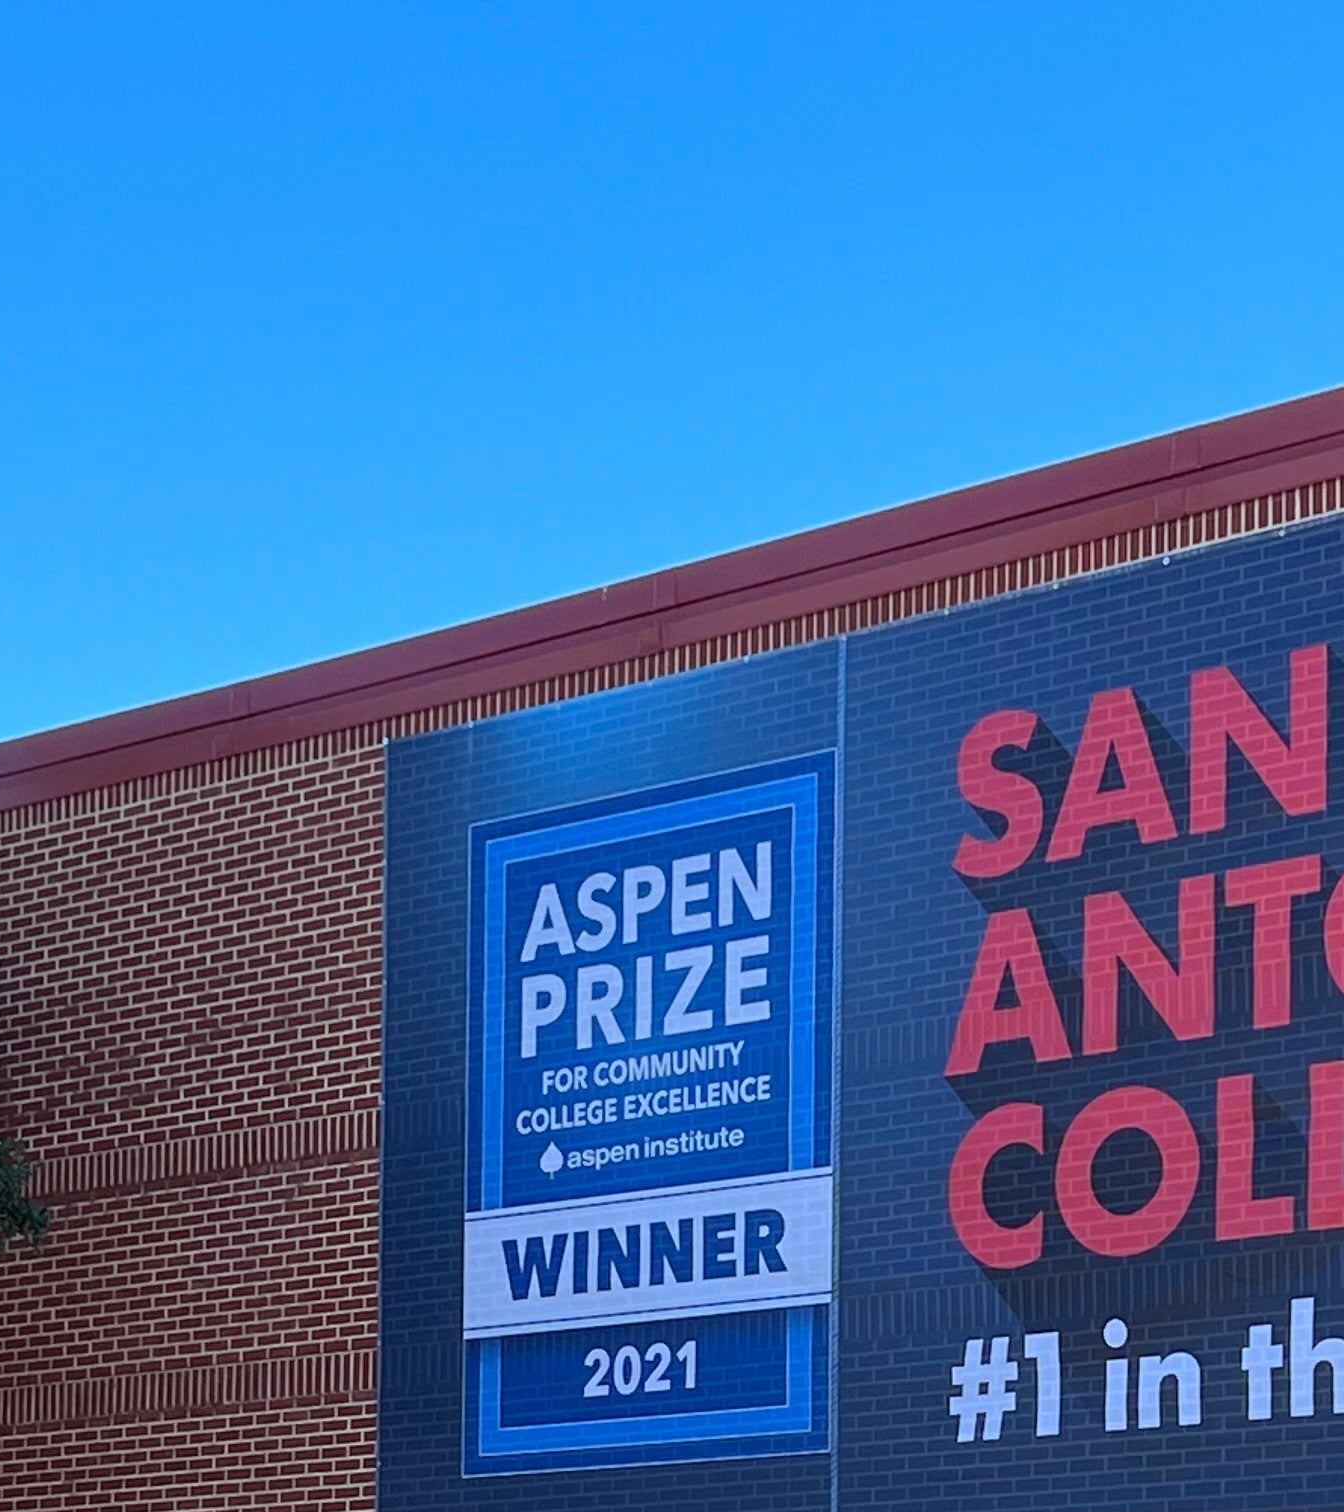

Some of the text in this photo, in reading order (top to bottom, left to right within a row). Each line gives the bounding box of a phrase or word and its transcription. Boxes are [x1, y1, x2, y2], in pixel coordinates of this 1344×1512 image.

[953, 644, 1329, 878] SAN
[520, 841, 772, 962] ASPEN
[520, 934, 771, 1058] PRIZE
[516, 1075, 772, 1135] COLLEGE EXCELLENCE
[541, 1040, 745, 1096] FOR COMMUNITY
[566, 1126, 745, 1171] aspen institute
[501, 1207, 789, 1302] WINNER
[582, 1339, 698, 1398] 2021
[949, 1330, 1061, 1444] #1
[1103, 1318, 1202, 1432] in
